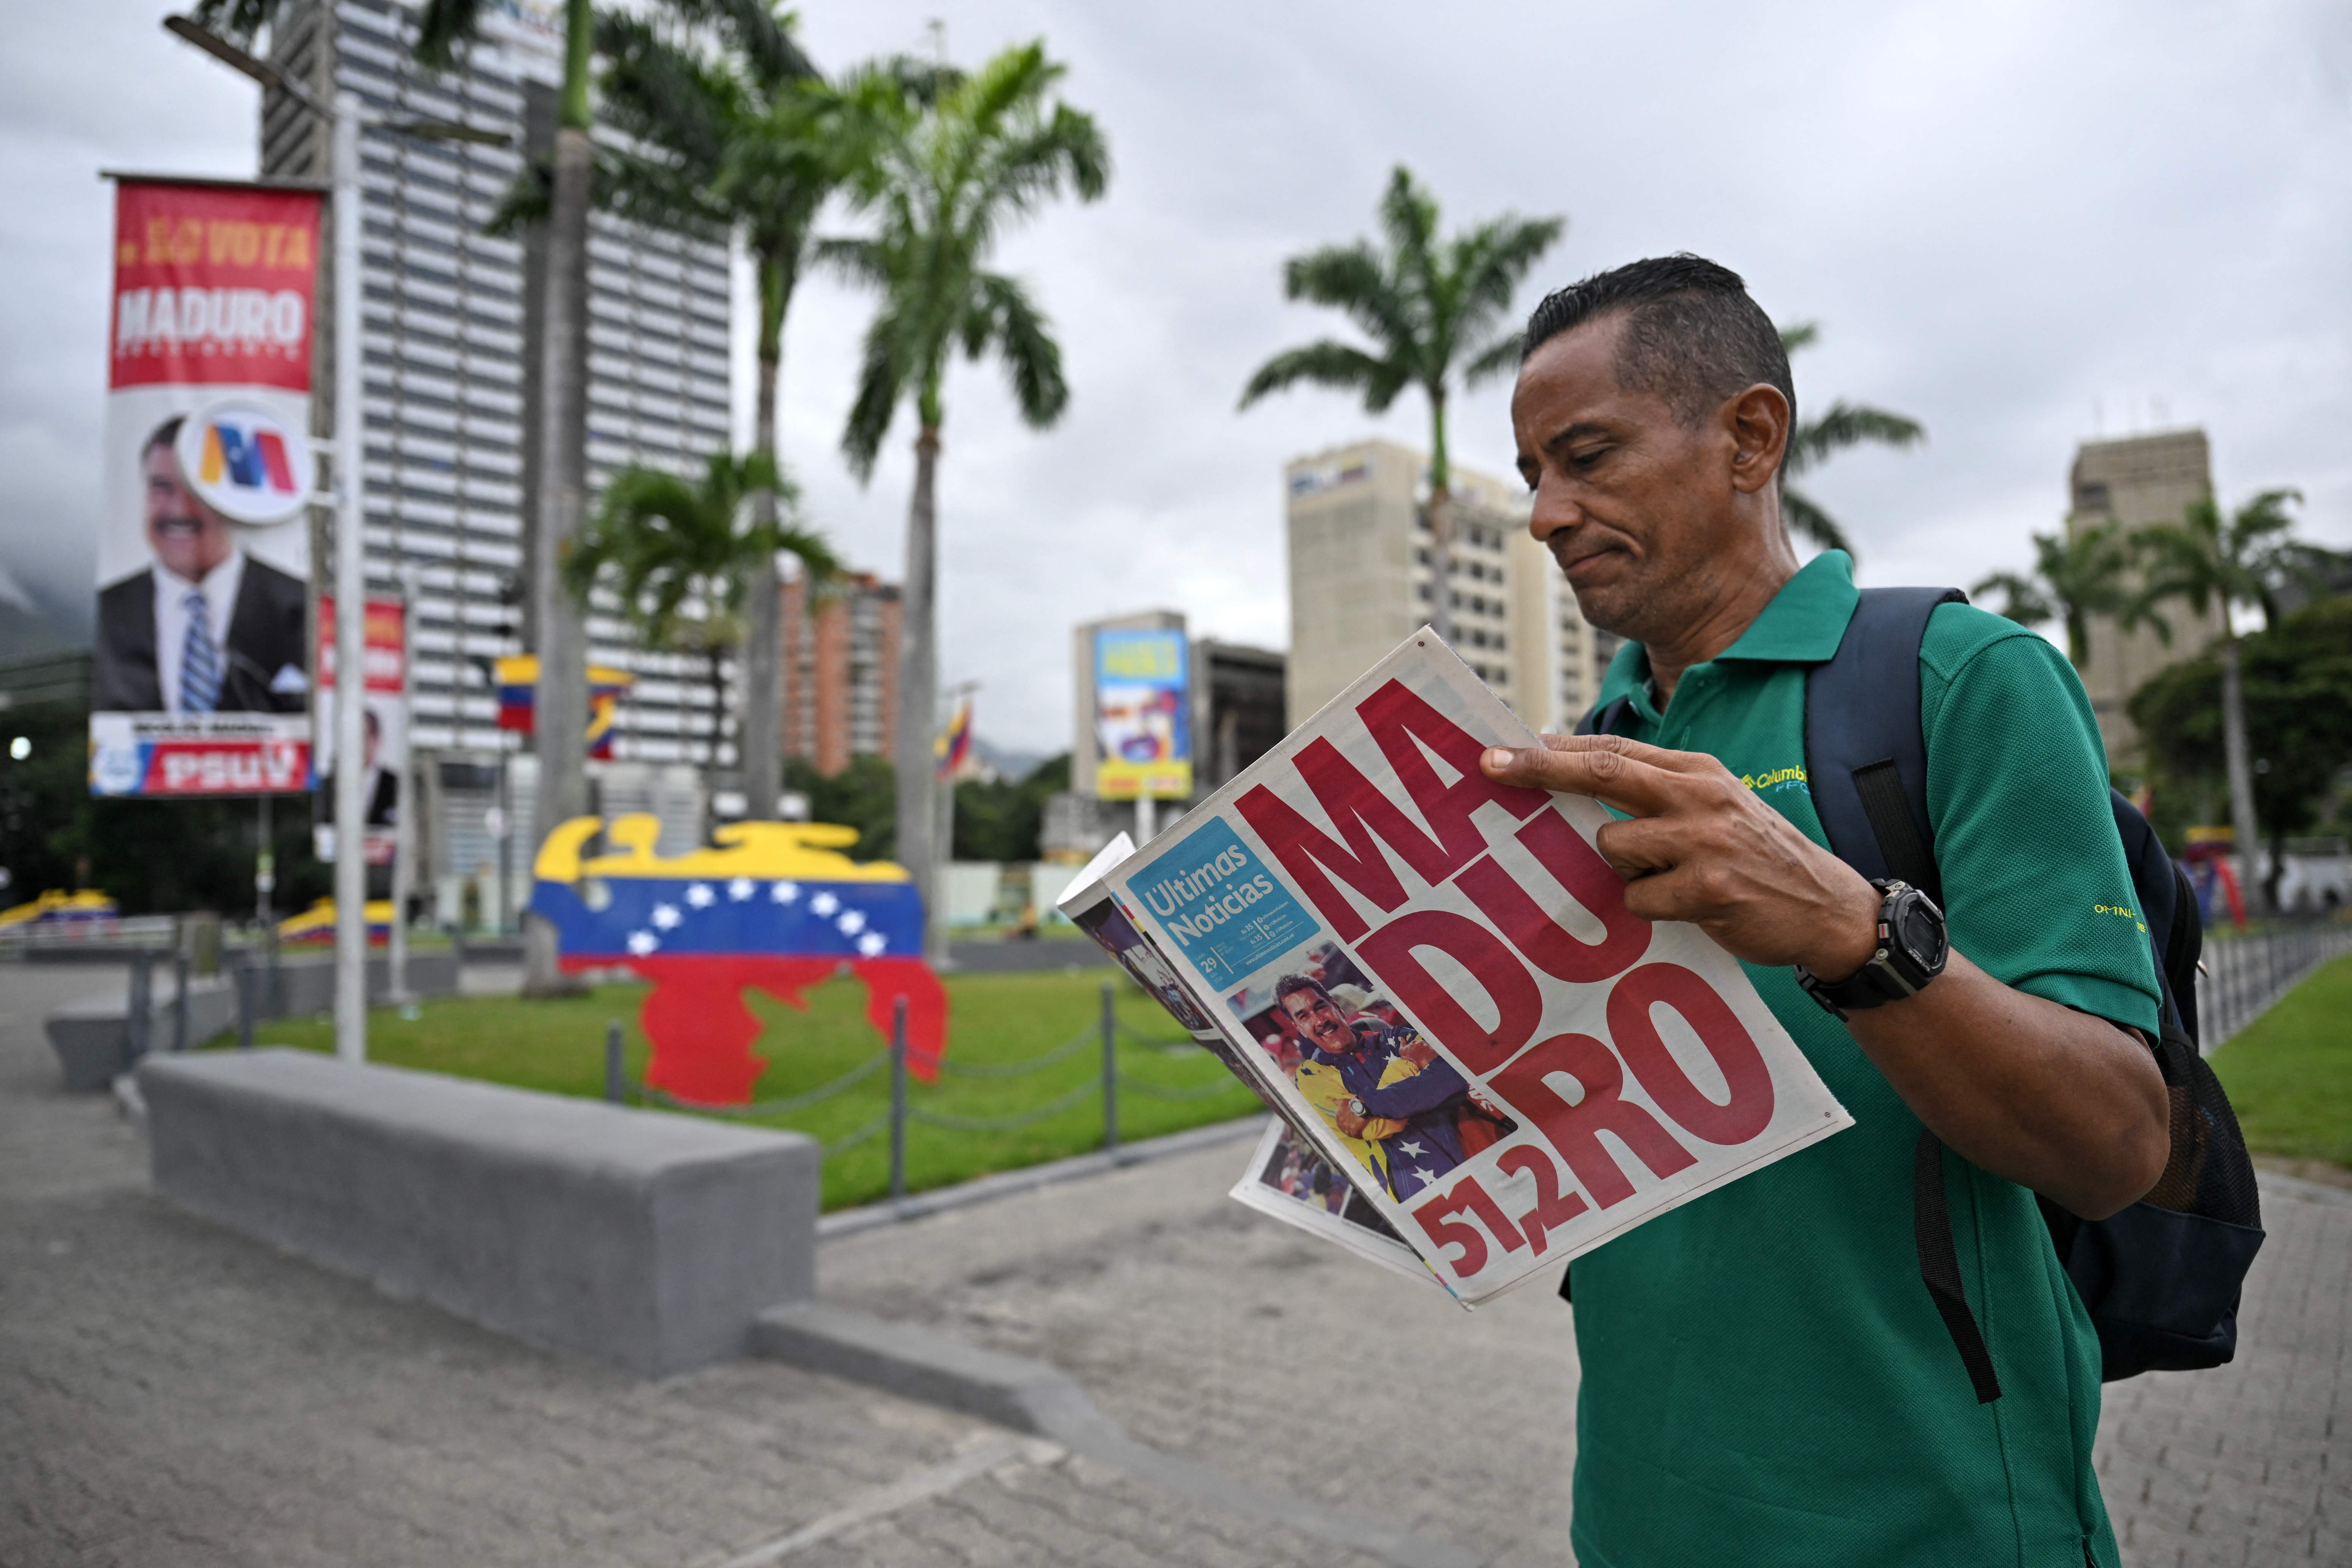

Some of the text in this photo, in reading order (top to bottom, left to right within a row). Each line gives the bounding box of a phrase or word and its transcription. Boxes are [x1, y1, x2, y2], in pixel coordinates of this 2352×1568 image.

[208, 220, 310, 268] VOTA
[117, 287, 305, 343] MADURO
[1233, 678, 1554, 945] MA
[1167, 874, 1273, 947] Noticias
[1354, 804, 1653, 1076] DU
[1200, 957, 1217, 973] 29
[1246, 933, 1295, 965] www.ultimasnoticias.com.ve
[1488, 962, 1774, 1210] RO
[1412, 1144, 1590, 1277] 51,2
